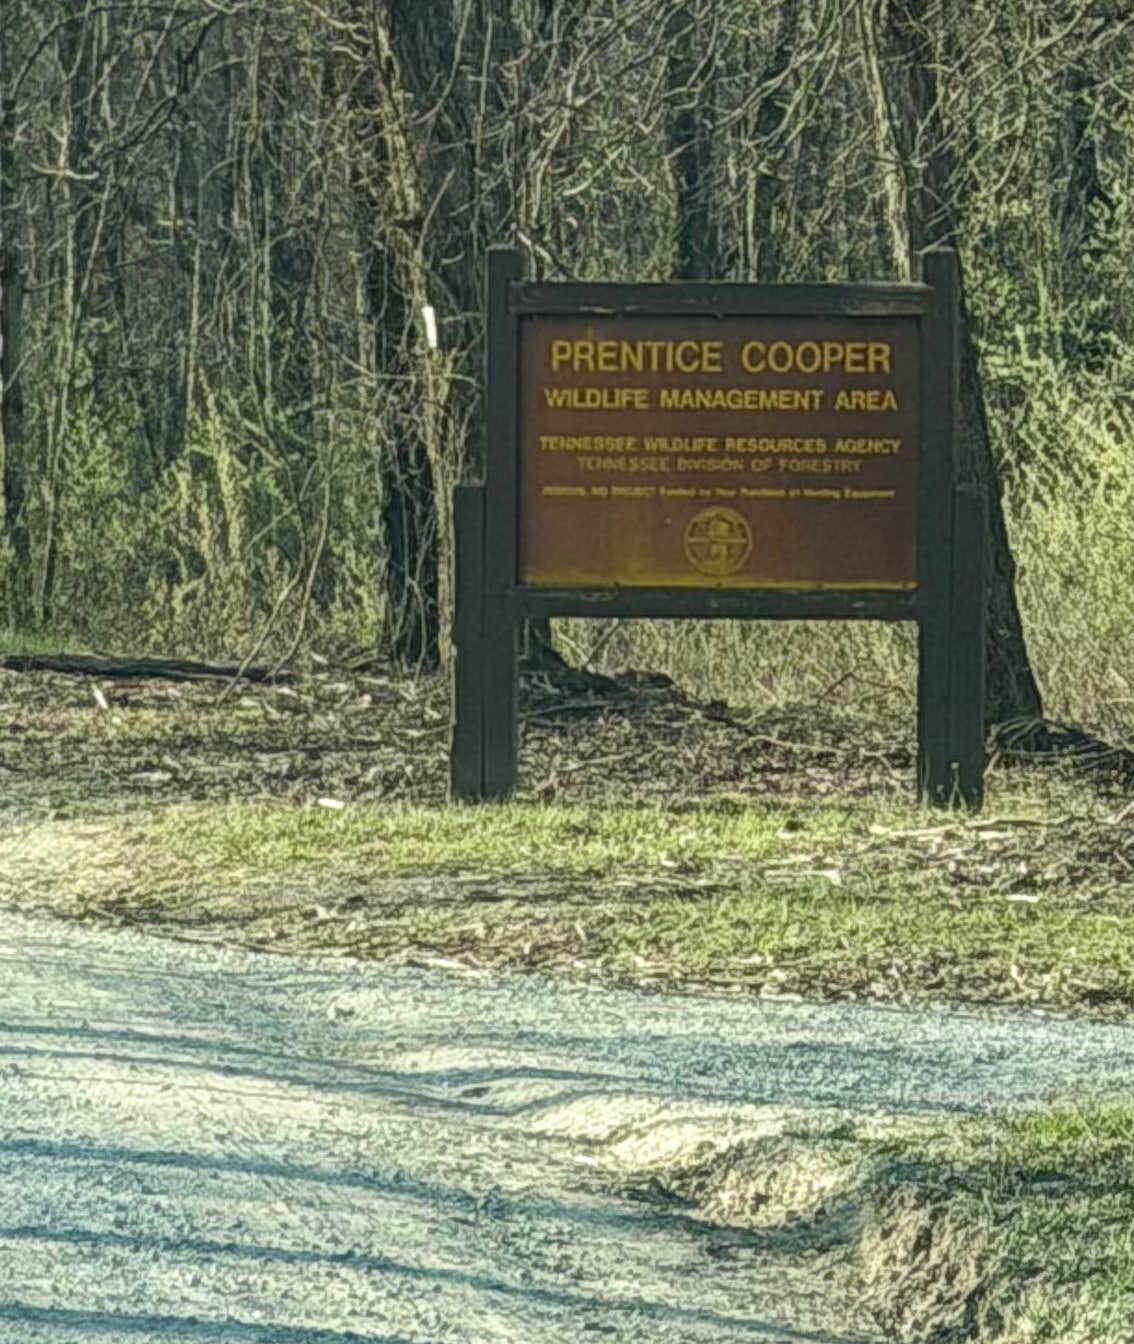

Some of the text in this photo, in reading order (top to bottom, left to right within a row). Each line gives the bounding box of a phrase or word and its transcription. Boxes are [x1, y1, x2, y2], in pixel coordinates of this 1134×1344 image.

[551, 340, 891, 373] PRENTICE COOPER
[544, 388, 898, 411] WILDLIFE MANAGEMENT AREA
[539, 436, 902, 454] TENNESSEE WILDLIFE RESOURCES AGENCY
[577, 456, 864, 473] TENNESSEE DIVISION OF FORESTRY
